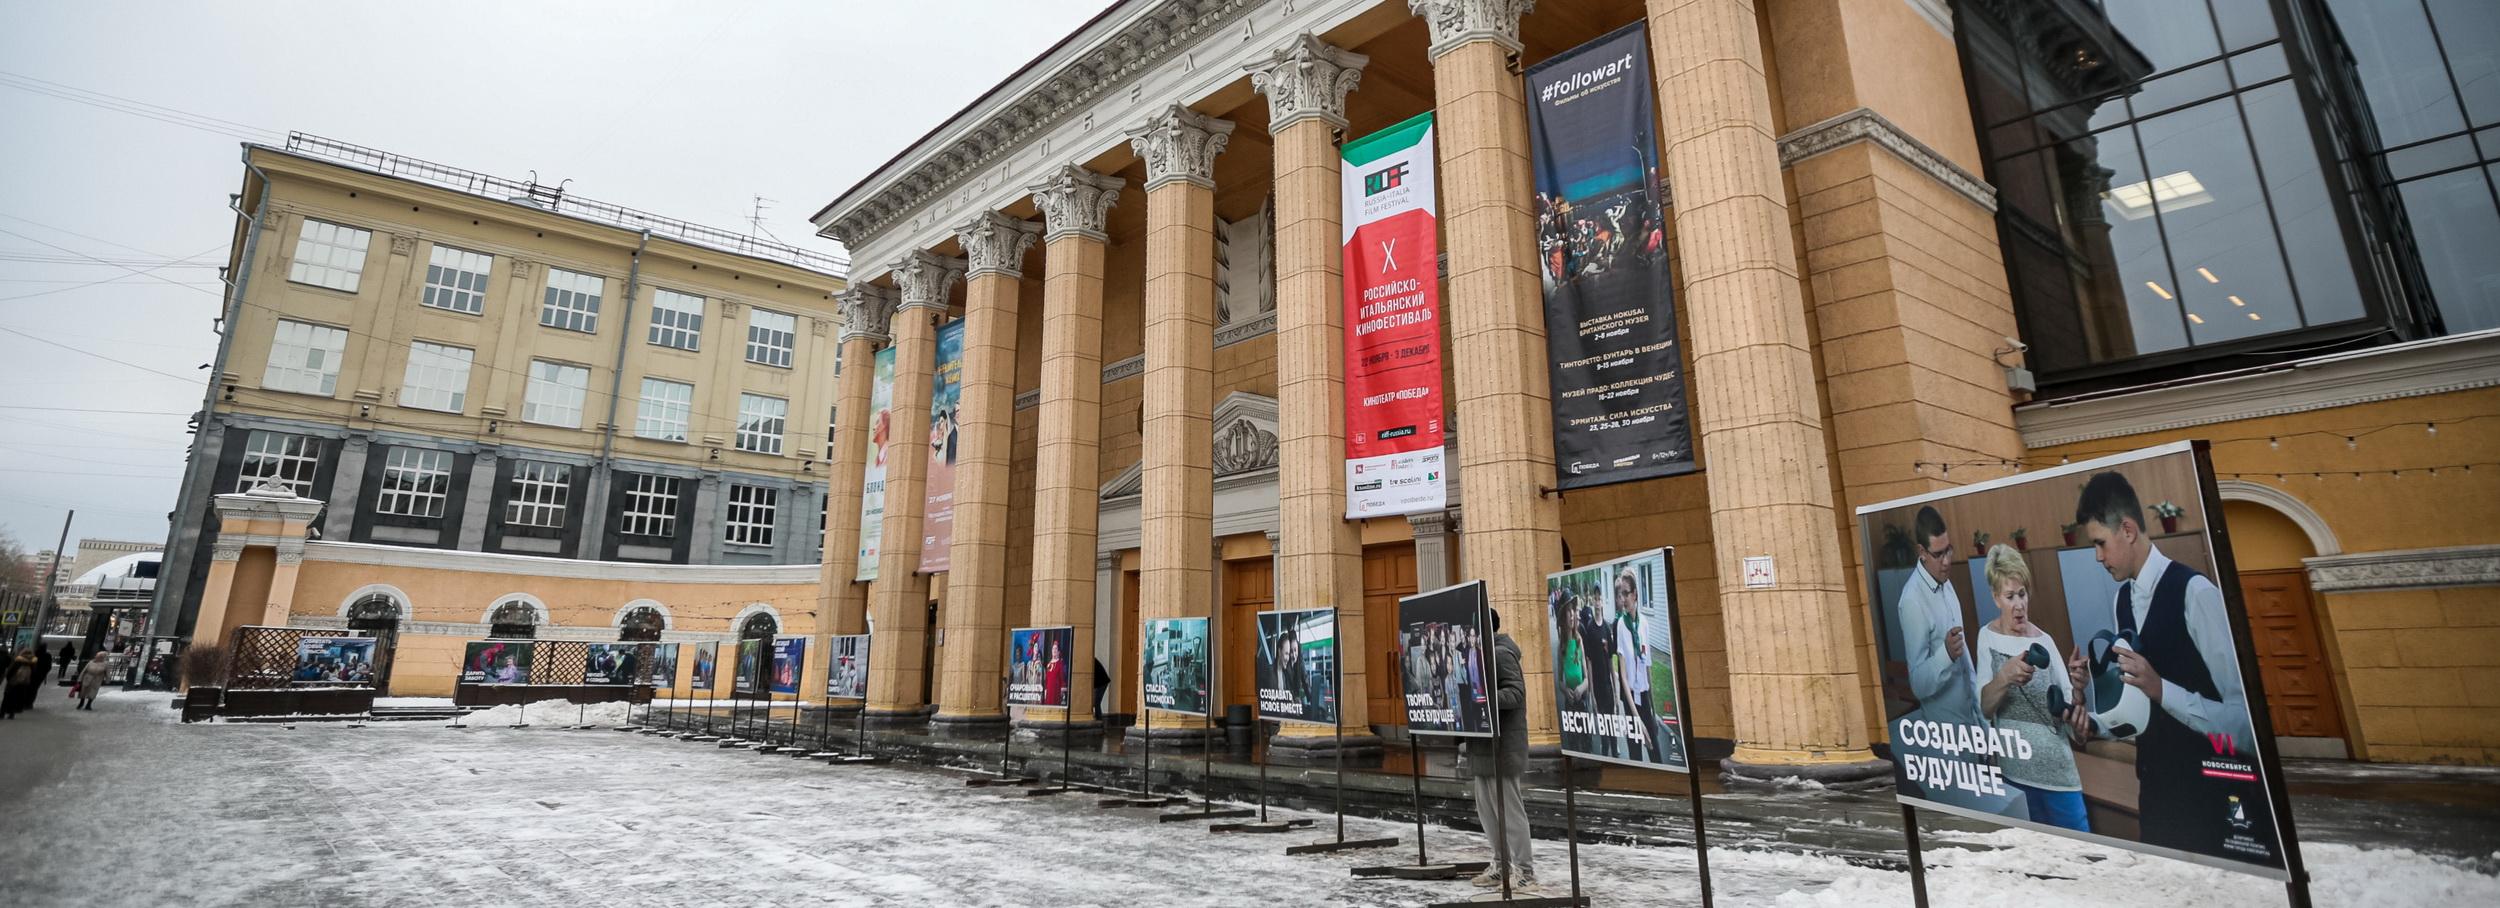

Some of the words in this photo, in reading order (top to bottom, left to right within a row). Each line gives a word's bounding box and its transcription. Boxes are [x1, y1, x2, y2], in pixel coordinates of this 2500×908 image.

[1542, 53, 1633, 102] #followart
[1554, 94, 1580, 106] Фильмы
[1580, 88, 1589, 98] об
[1590, 77, 1621, 94] искусства
[1364, 204, 1380, 216] FILM
[1380, 196, 1410, 212] FESTIVAL
[1363, 278, 1421, 302] РОССИЙСКО-
[1359, 291, 1425, 320] ИТАЛЬЯНСКИЙ
[1355, 308, 1433, 336] КИНОФЕСТИВАЛЬ
[1579, 320, 1624, 337] БРИТАНСКОГО
[1625, 315, 1650, 326] МУЗЕЯ
[1580, 313, 1612, 329] ВЫСТАВКА
[1613, 307, 1645, 320] HOKUSAI
[1606, 327, 1630, 339] ноября
[1368, 351, 1389, 365] НОЯБРЯ
[1400, 344, 1431, 359] ДЕКАБРЯ
[1603, 350, 1634, 361] БУНТАРЬ
[1641, 340, 1673, 353] ВЕНЕЦИИ
[1610, 357, 1634, 369] ноября
[1562, 388, 1586, 399] МУЗЕЙ
[1610, 376, 1653, 390] КОЛЛЕКЦИЯ
[1653, 371, 1676, 382] ЧУДЕС
[1615, 388, 1640, 399] ноября
[1363, 392, 1396, 407] КИНОТЕАТР
[1396, 386, 1429, 400] «ПОБЕДА»
[1609, 410, 1629, 420] СИЛА
[1630, 403, 1674, 416] ИСКУССТВА
[1631, 415, 1656, 426] ноября
[1145, 683, 1168, 694] СПАСАТЬ
[1259, 688, 1293, 701] СОЗДАВАТЬ
[1150, 694, 1175, 706] ПОМОГАТЬ
[1260, 700, 1280, 712] НОВОЕ
[1280, 702, 1304, 715] ВМЕСТЕ
[1405, 693, 1434, 706] ТВОРИТЬ
[1408, 709, 1426, 722] СВОЕ
[1425, 709, 1455, 725] БУДУЩЕЕ
[1561, 710, 1597, 735] ВЕСТИ
[1597, 712, 1646, 745] ВПЕРЕД
[1899, 718, 2033, 761] СОЗДАВАТЬ
[1903, 753, 2006, 797] БУДУЩЕЕ
[2201, 760, 2253, 772] НОВОСИБИРСК
